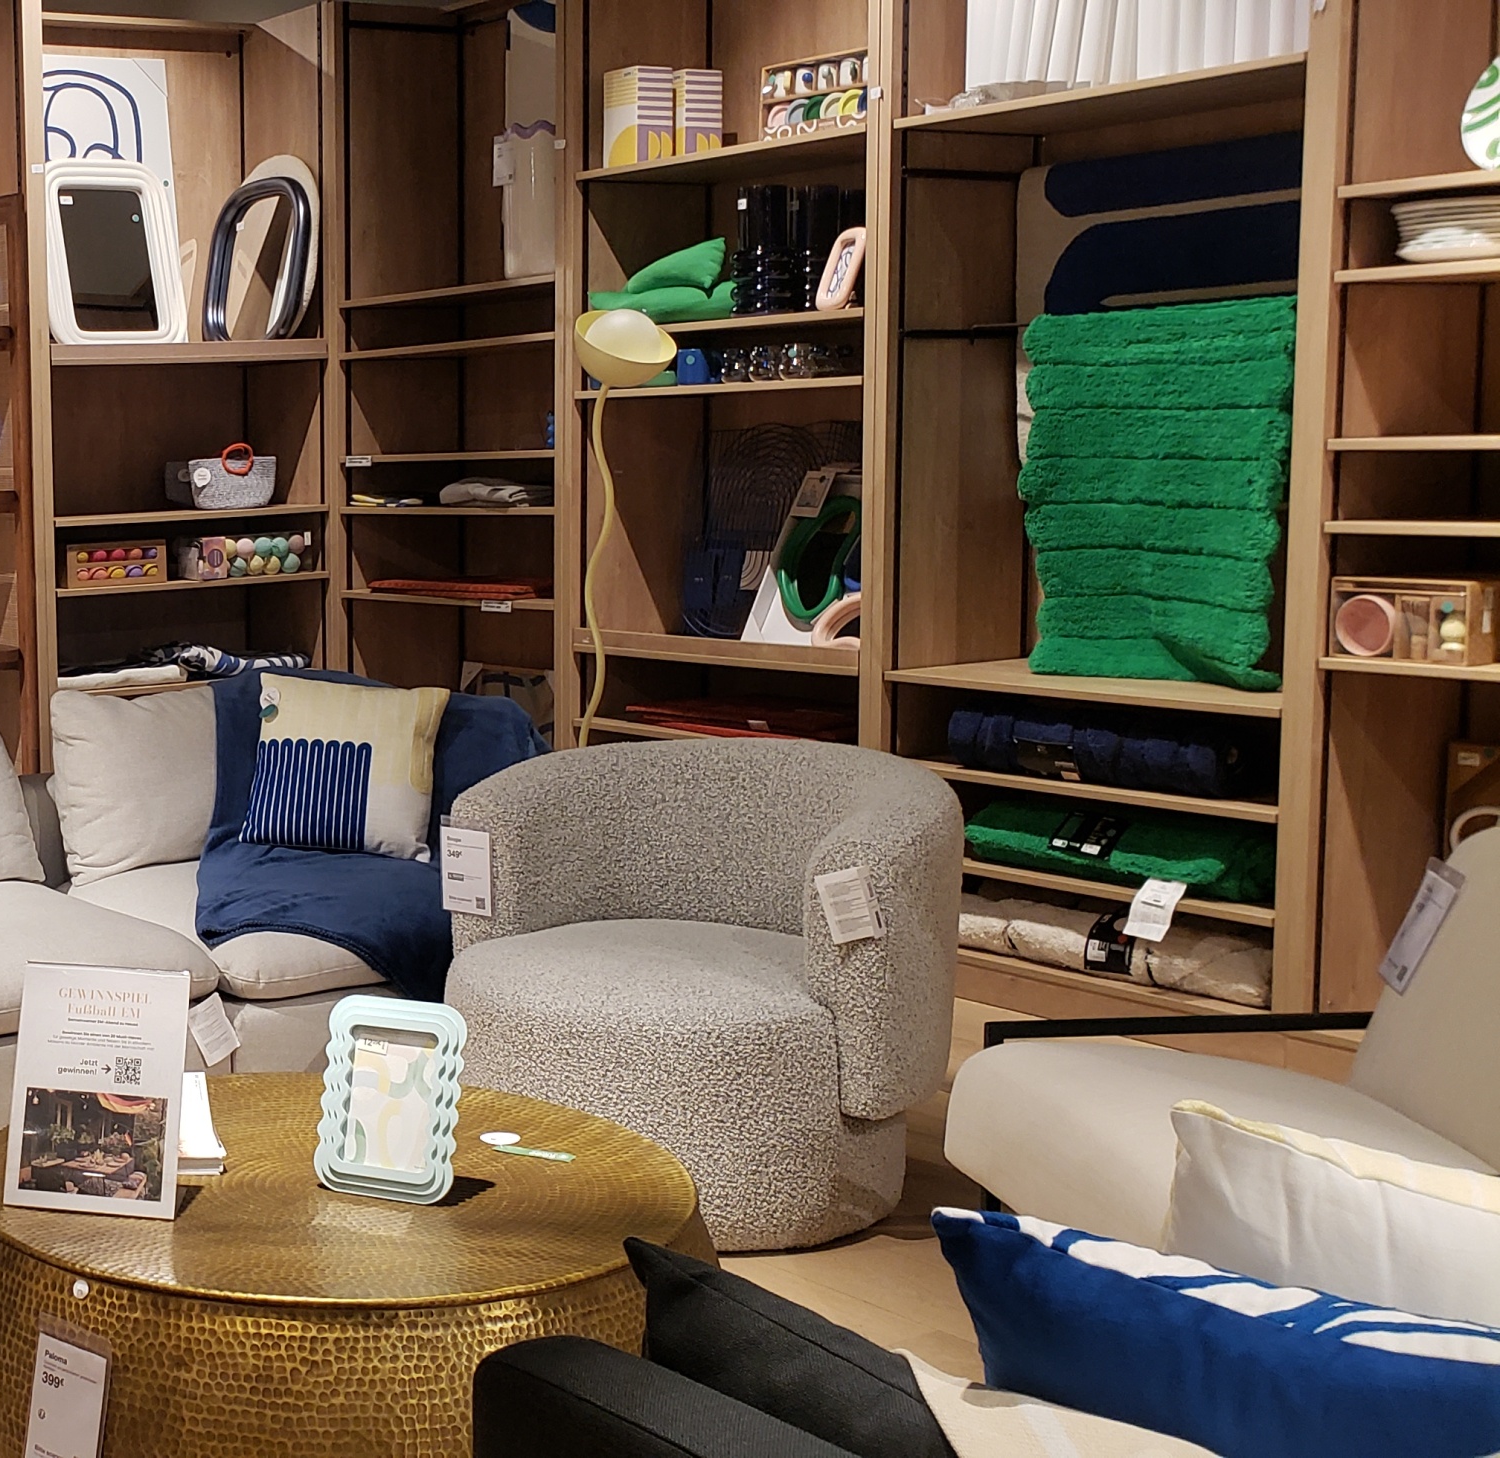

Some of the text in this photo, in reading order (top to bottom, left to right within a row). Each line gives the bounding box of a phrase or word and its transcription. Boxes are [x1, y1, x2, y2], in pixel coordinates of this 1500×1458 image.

[58, 987, 152, 1005] GEWINNSPIEL
[68, 1003, 140, 1019] Fußball EM
[80, 1058, 98, 1067] Jetzt
[57, 1066, 98, 1076] gewinnen!
[45, 1349, 68, 1366] Paloma
[42, 1371, 65, 1389] 399€
